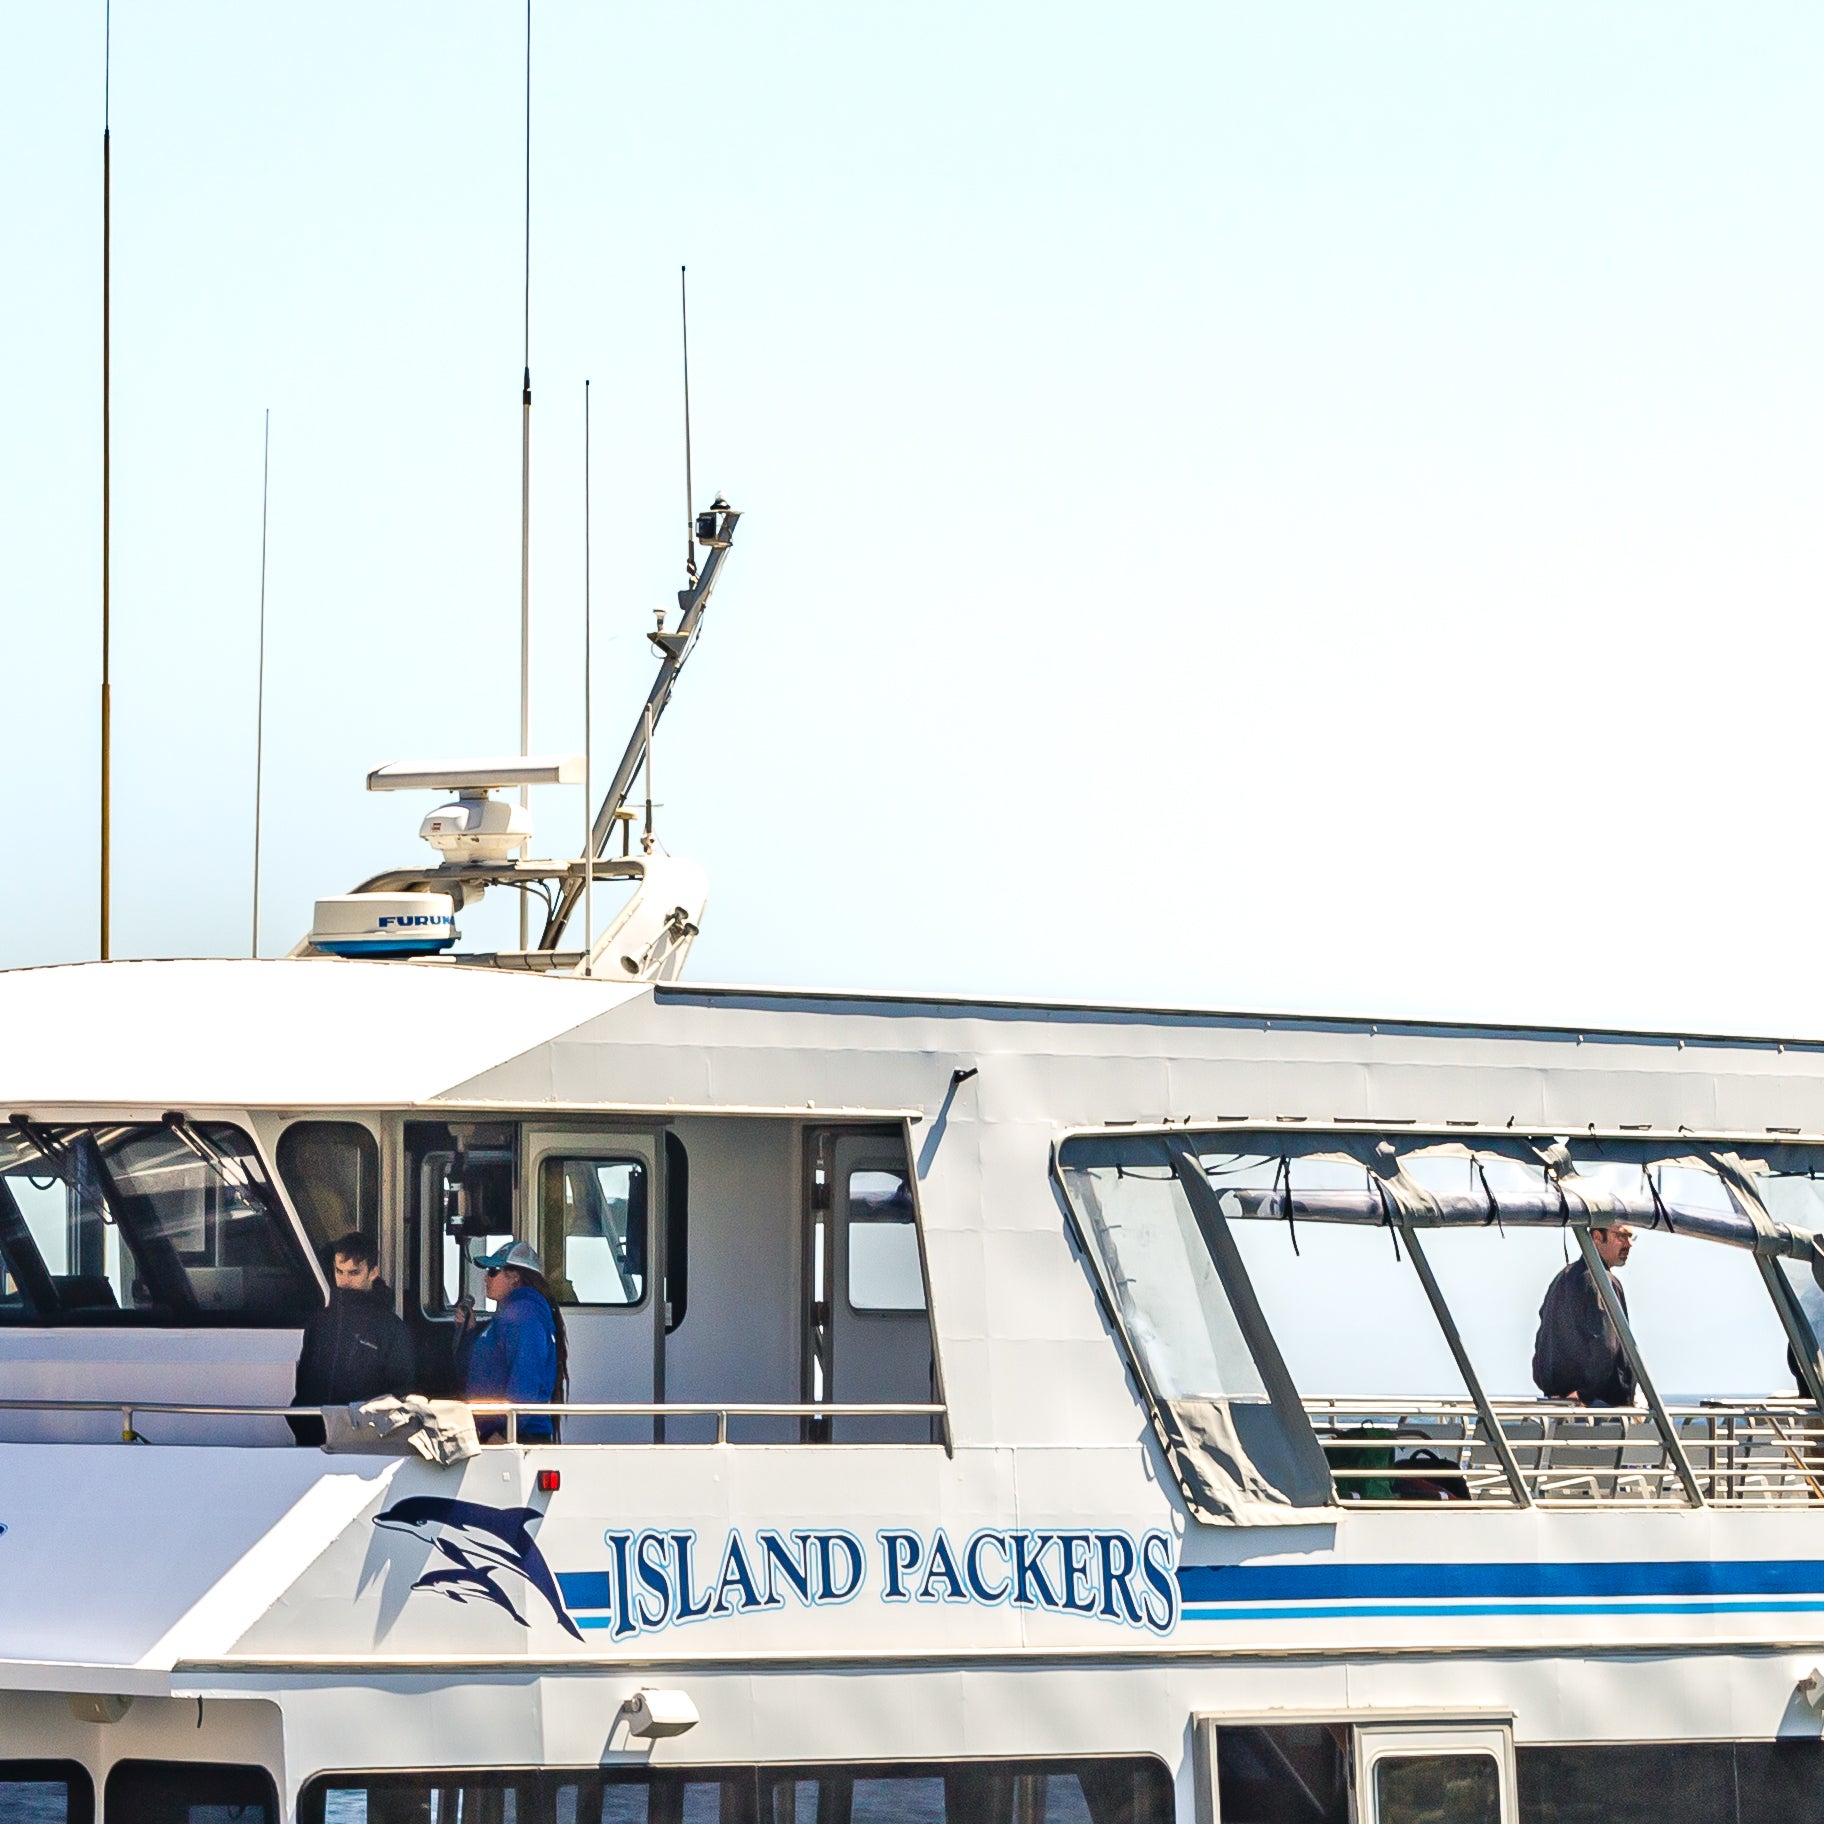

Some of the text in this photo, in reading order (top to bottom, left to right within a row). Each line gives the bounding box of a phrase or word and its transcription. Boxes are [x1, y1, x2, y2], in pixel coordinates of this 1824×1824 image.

[378, 915, 455, 928] FURUN
[605, 1530, 1178, 1641] ISLAND PACKERS
